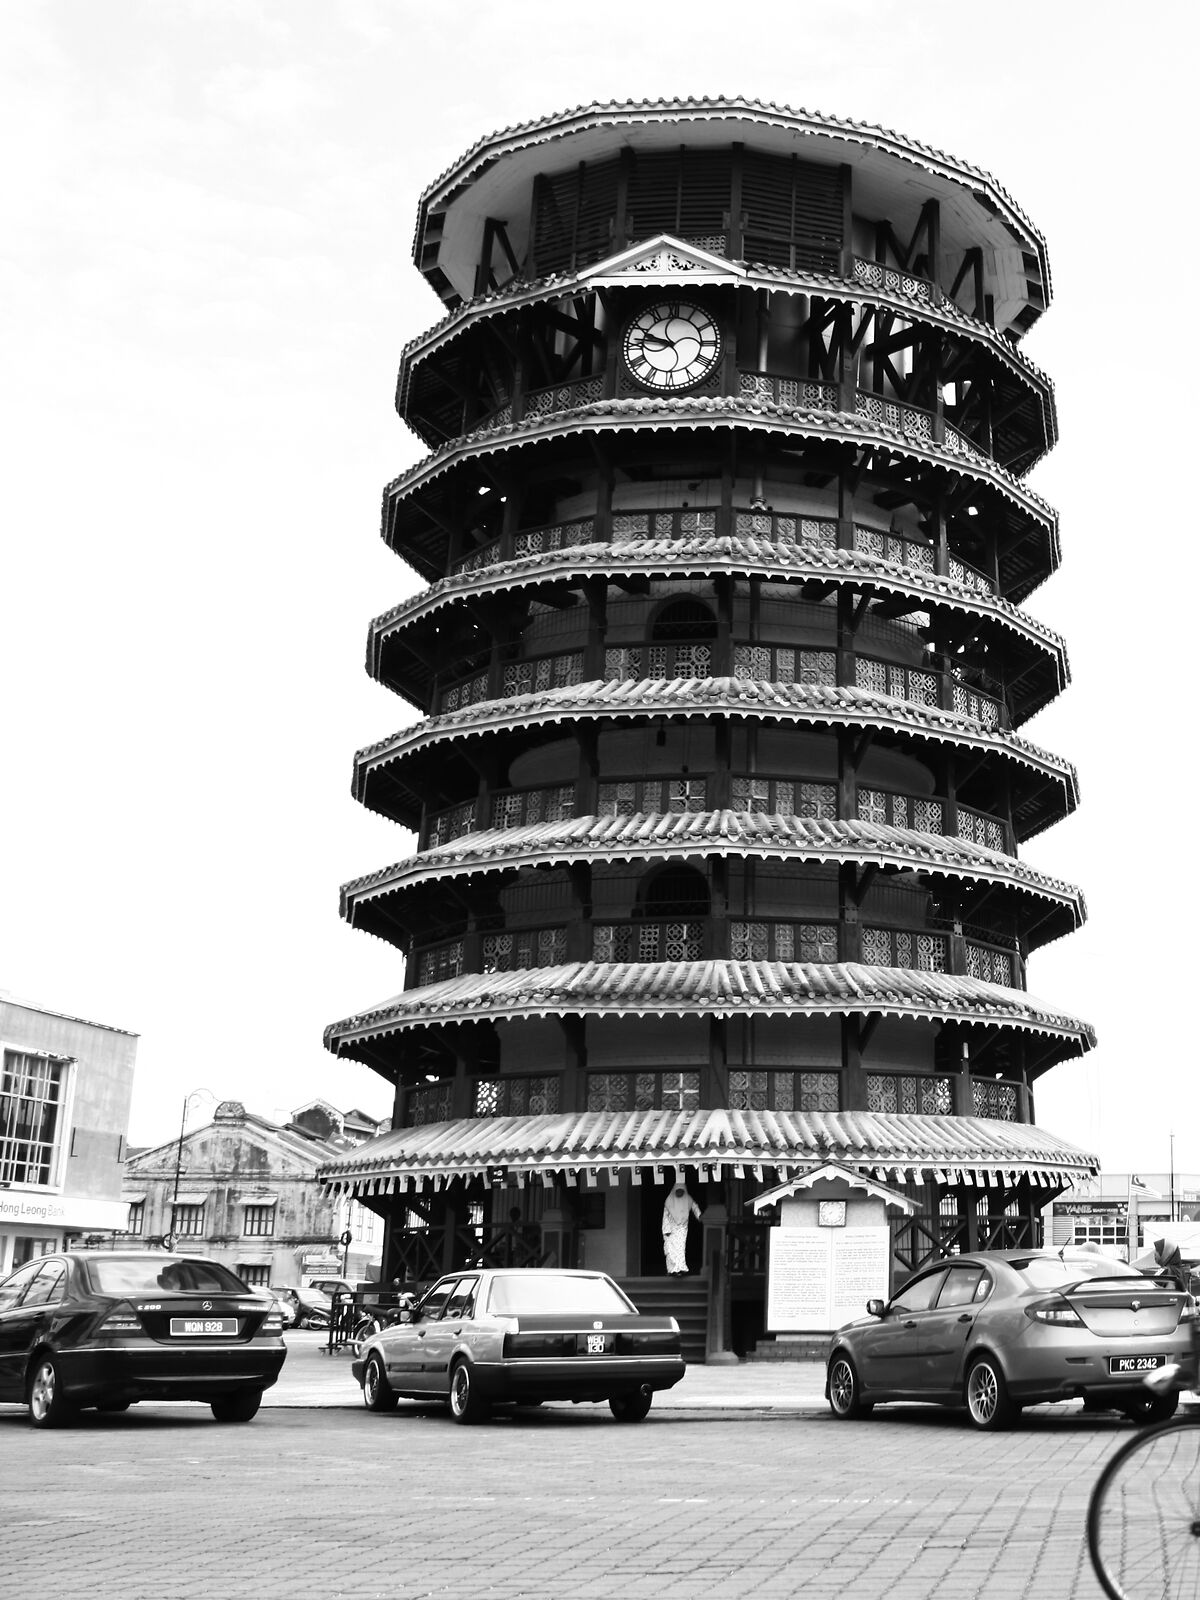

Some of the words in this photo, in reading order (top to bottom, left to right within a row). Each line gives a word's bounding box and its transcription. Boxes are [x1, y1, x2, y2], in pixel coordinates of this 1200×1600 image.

[21, 1202, 47, 1219] Leong
[204, 1322, 223, 1332] 928
[1120, 1359, 1135, 1371] PKC
[1136, 1358, 1157, 1370] 2342
